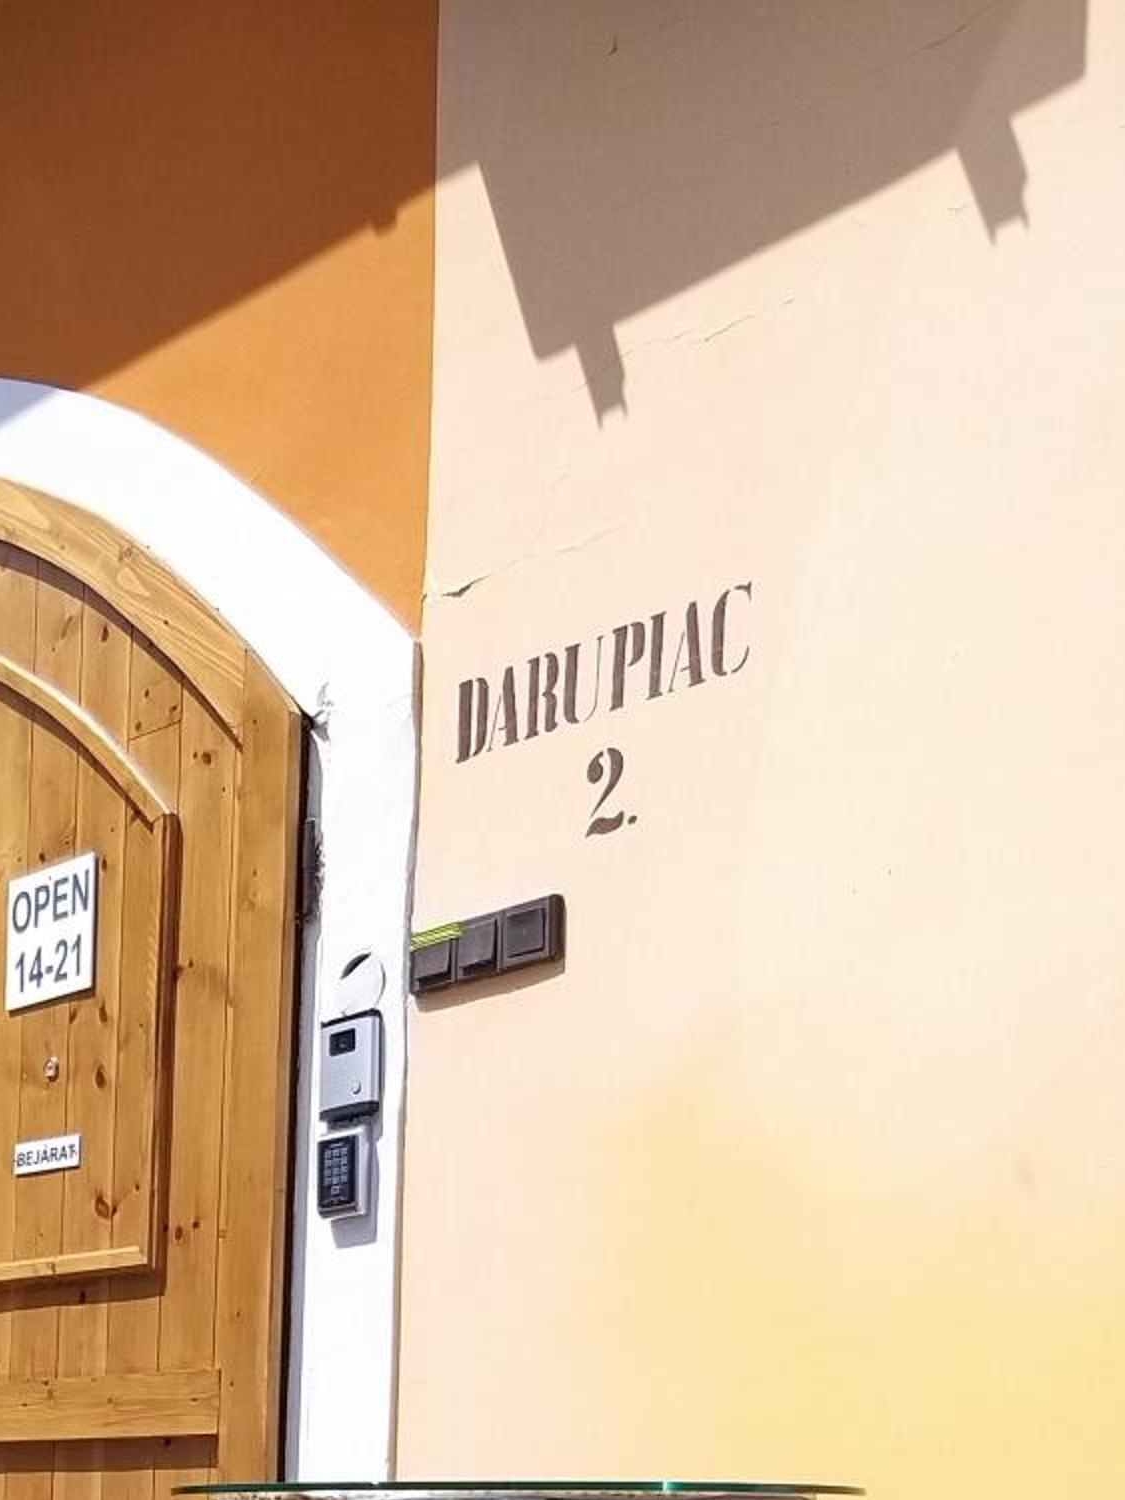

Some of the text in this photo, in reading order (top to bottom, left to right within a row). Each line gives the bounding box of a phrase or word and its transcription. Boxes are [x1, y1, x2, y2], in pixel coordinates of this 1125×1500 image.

[455, 581, 753, 764] DARUPIAC
[585, 747, 638, 838] 2.
[12, 868, 90, 934] OPEN
[15, 933, 82, 993] 14-21
